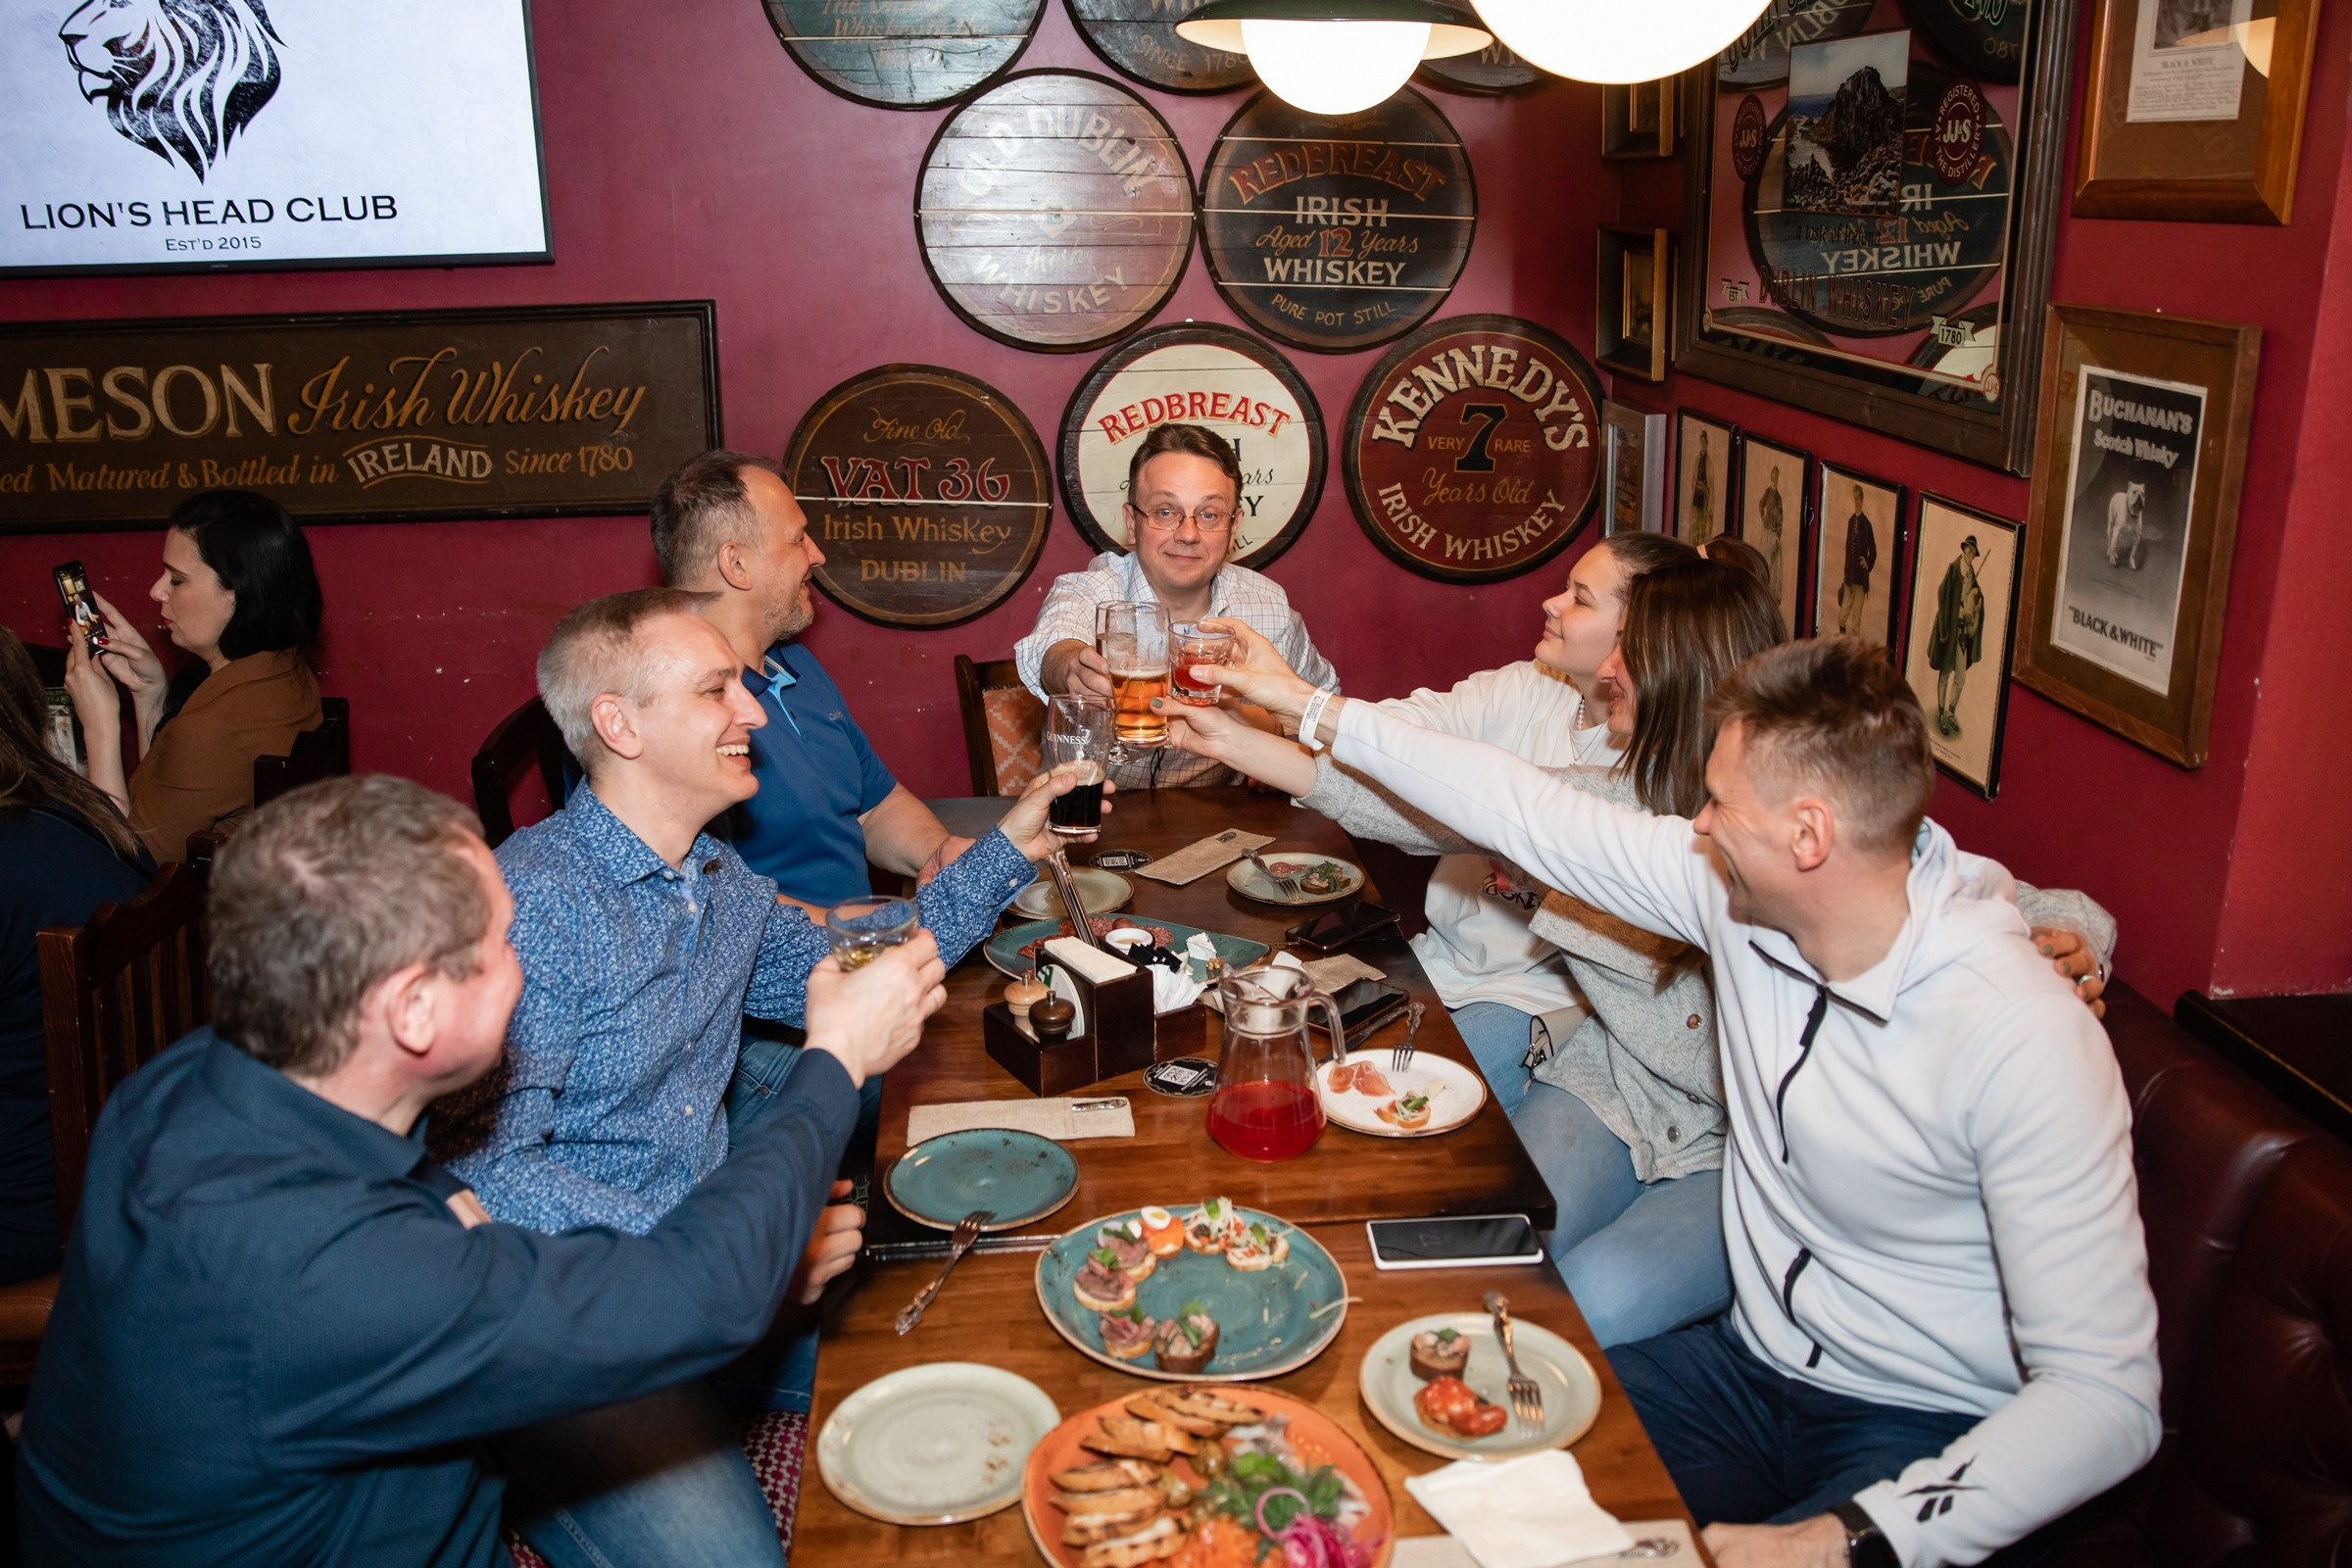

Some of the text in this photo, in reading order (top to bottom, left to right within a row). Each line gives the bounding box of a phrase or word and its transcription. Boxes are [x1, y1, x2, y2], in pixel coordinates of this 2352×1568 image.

[1939, 84, 1980, 116] REGISTERED
[956, 108, 1160, 197] OLD DUBLIN
[1948, 122, 1982, 177] DISTILLERY
[1229, 143, 1446, 206] REDBREAST
[20, 195, 399, 229] LION'S HEAD CLUB
[1296, 196, 1389, 227] IRISH
[218, 236, 263, 250] 2015
[1256, 225, 1419, 260] Aged 12 Years
[973, 255, 1129, 315] WHISKEY
[1263, 257, 1407, 286] WHISKEY
[1272, 293, 1396, 326] PURE POT STILL
[1759, 266, 1916, 330] DUBLIN WHISKEY
[1940, 328, 1962, 344] 1780
[287, 347, 458, 434] Irish
[447, 345, 646, 437] Whiskey
[1372, 345, 1590, 451] KENNEDY'S
[863, 407, 970, 444] Fine Old
[1098, 392, 1292, 445] REDBREAST
[2088, 389, 2193, 435] BUCHANAN'S
[1428, 436, 1532, 453] VERY RARE
[1454, 403, 1508, 473] 7
[46, 463, 171, 491] Matured
[177, 463, 198, 488] &
[200, 455, 301, 488] Bottled
[310, 456, 339, 484] in
[347, 443, 493, 483] IRELAND
[505, 448, 572, 475] Since
[577, 445, 634, 477] 1780
[820, 457, 1010, 506] VAT 36
[1241, 468, 1274, 485] ars
[1422, 466, 1535, 507] Years Old
[824, 514, 1011, 555] Irish Whiskey
[1378, 482, 1566, 561] IRISH WHISKEY
[860, 560, 966, 583] DUBLIN
[1047, 730, 1087, 745] GUINNESS
